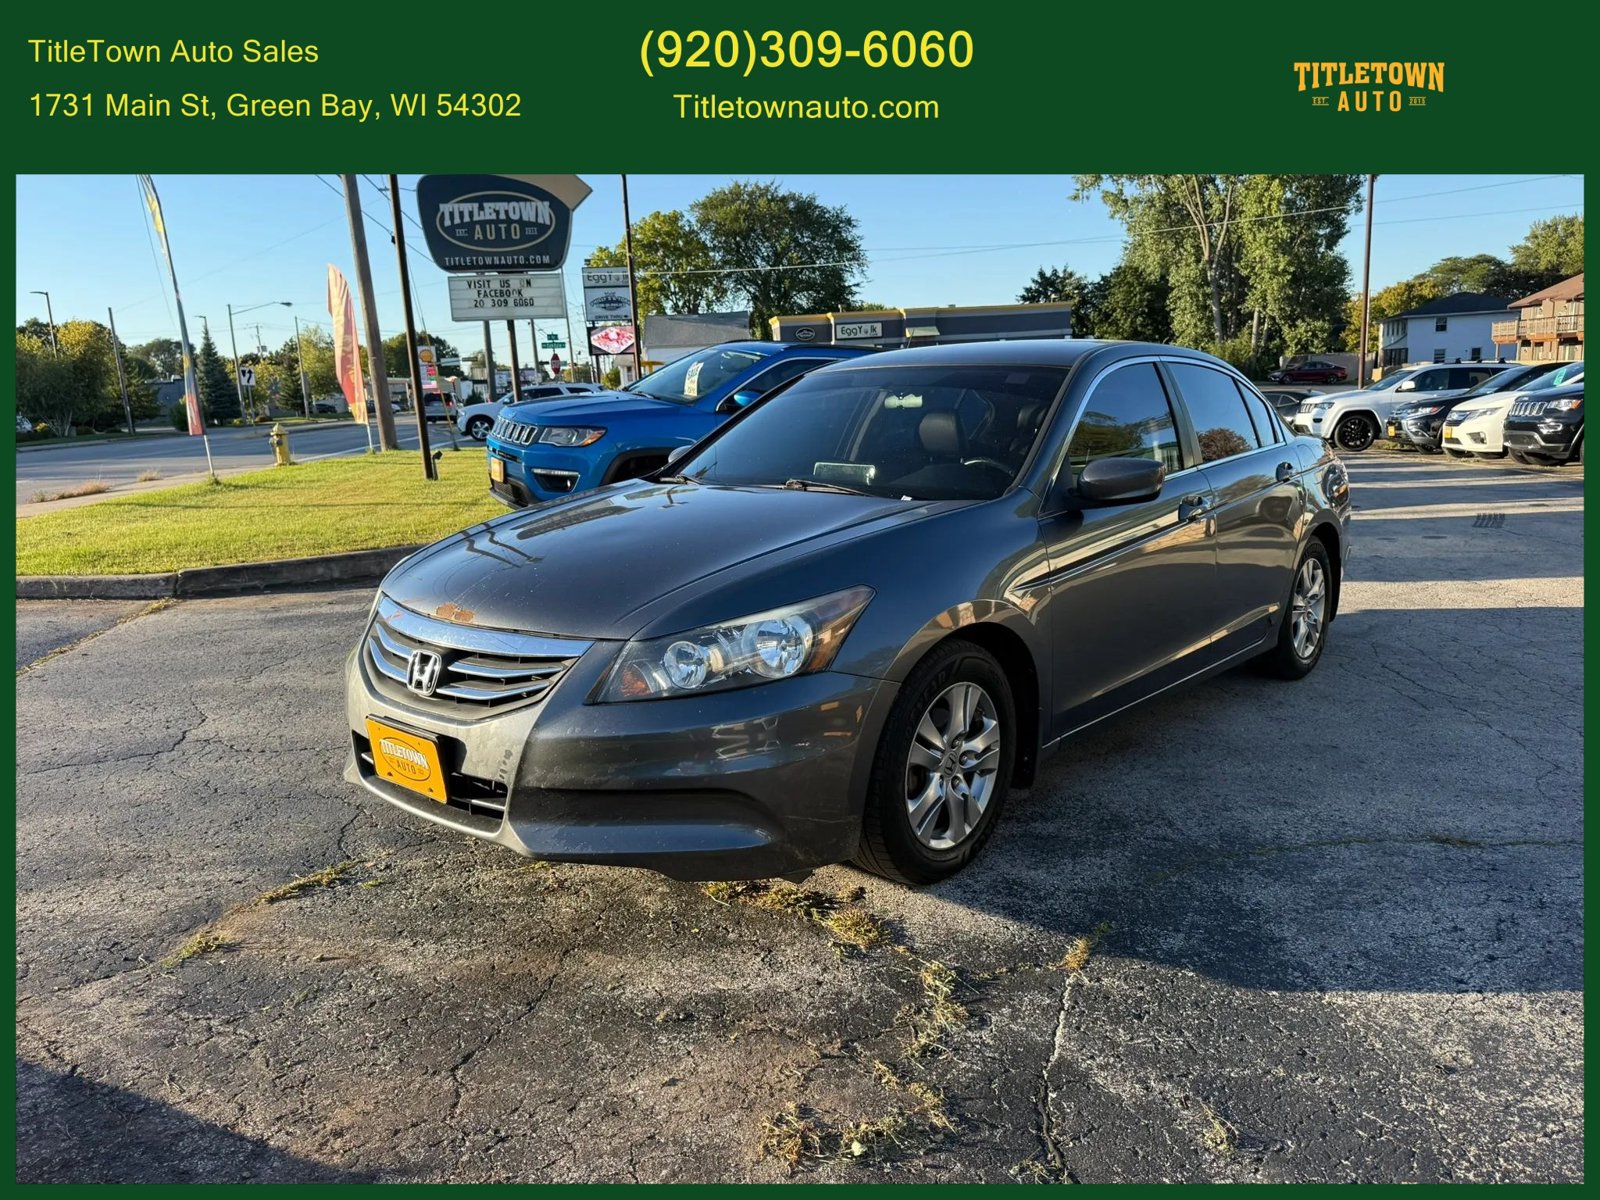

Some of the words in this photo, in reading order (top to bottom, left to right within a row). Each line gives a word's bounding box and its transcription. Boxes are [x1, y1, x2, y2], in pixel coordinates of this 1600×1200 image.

[439, 201, 550, 227] TITLETOWN
[474, 223, 521, 240] AUTO
[444, 255, 550, 266] TITLETOWNAUTO.COM
[467, 280, 491, 289] VISIT
[500, 279, 511, 288] US
[474, 299, 485, 308] 20
[491, 299, 508, 307] 309
[513, 298, 534, 307] 6060
[396, 760, 417, 774] AUTO
